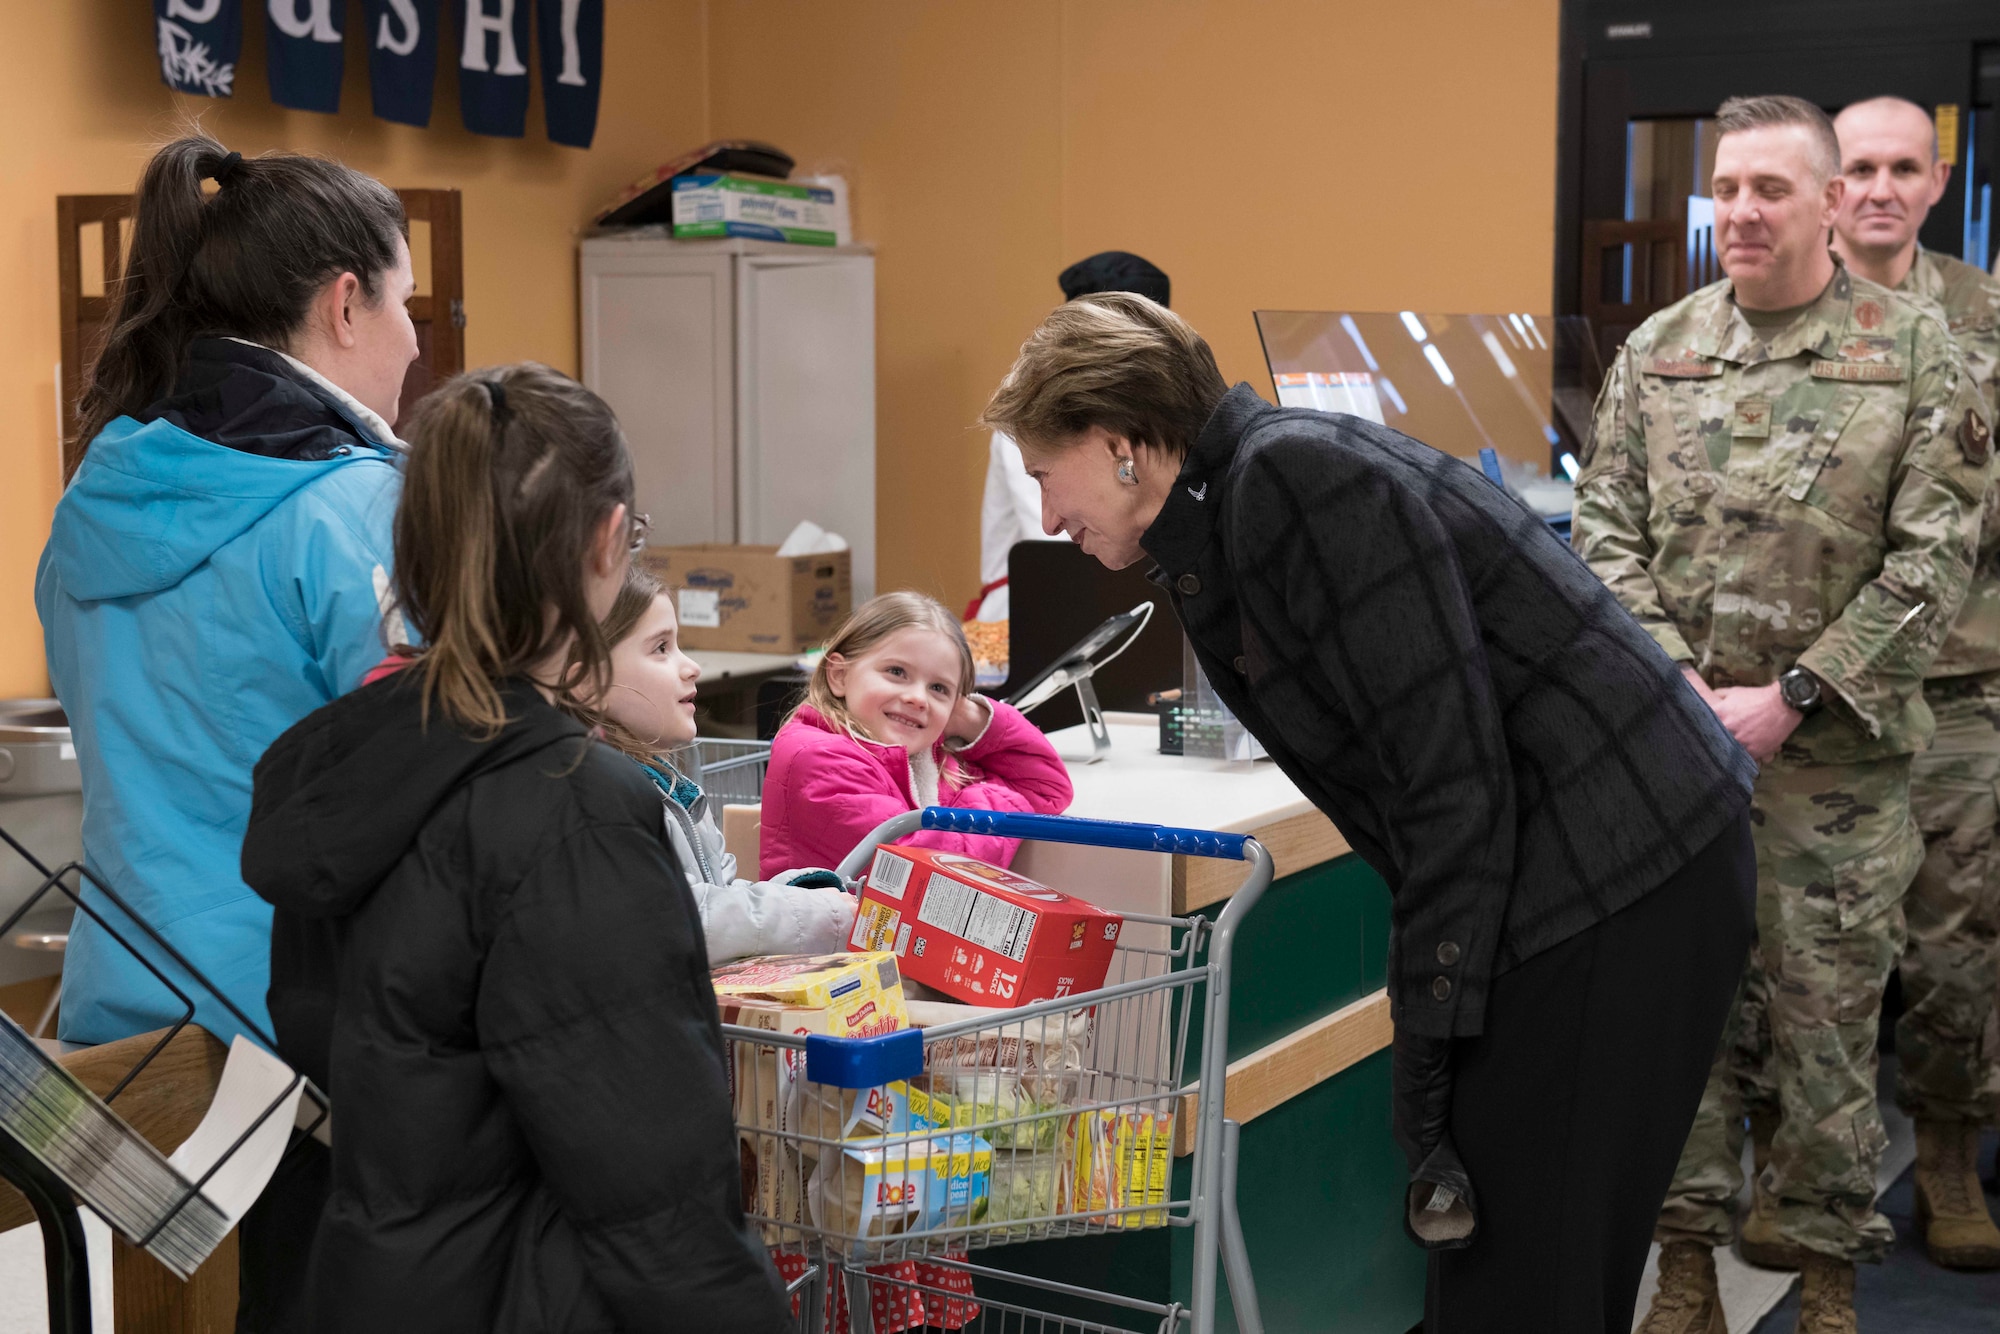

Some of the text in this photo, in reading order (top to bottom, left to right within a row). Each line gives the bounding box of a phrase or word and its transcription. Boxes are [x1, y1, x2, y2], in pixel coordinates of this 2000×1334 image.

[166, 0, 587, 86] SHI
[1816, 362, 1901, 380] US AIR FORCE
[878, 906, 887, 923] EARN
[876, 909, 892, 952] COLLECT POINTS
[1002, 907, 1021, 956] Calories 140
[1017, 914, 1037, 961] Nutrition Facts
[989, 967, 1001, 994] PACKS
[996, 972, 1017, 999] 12
[1053, 985, 1071, 999] 12
[877, 1179, 915, 1205] Dole
[950, 1179, 969, 1190] dice
[950, 1190, 969, 1202] pear
